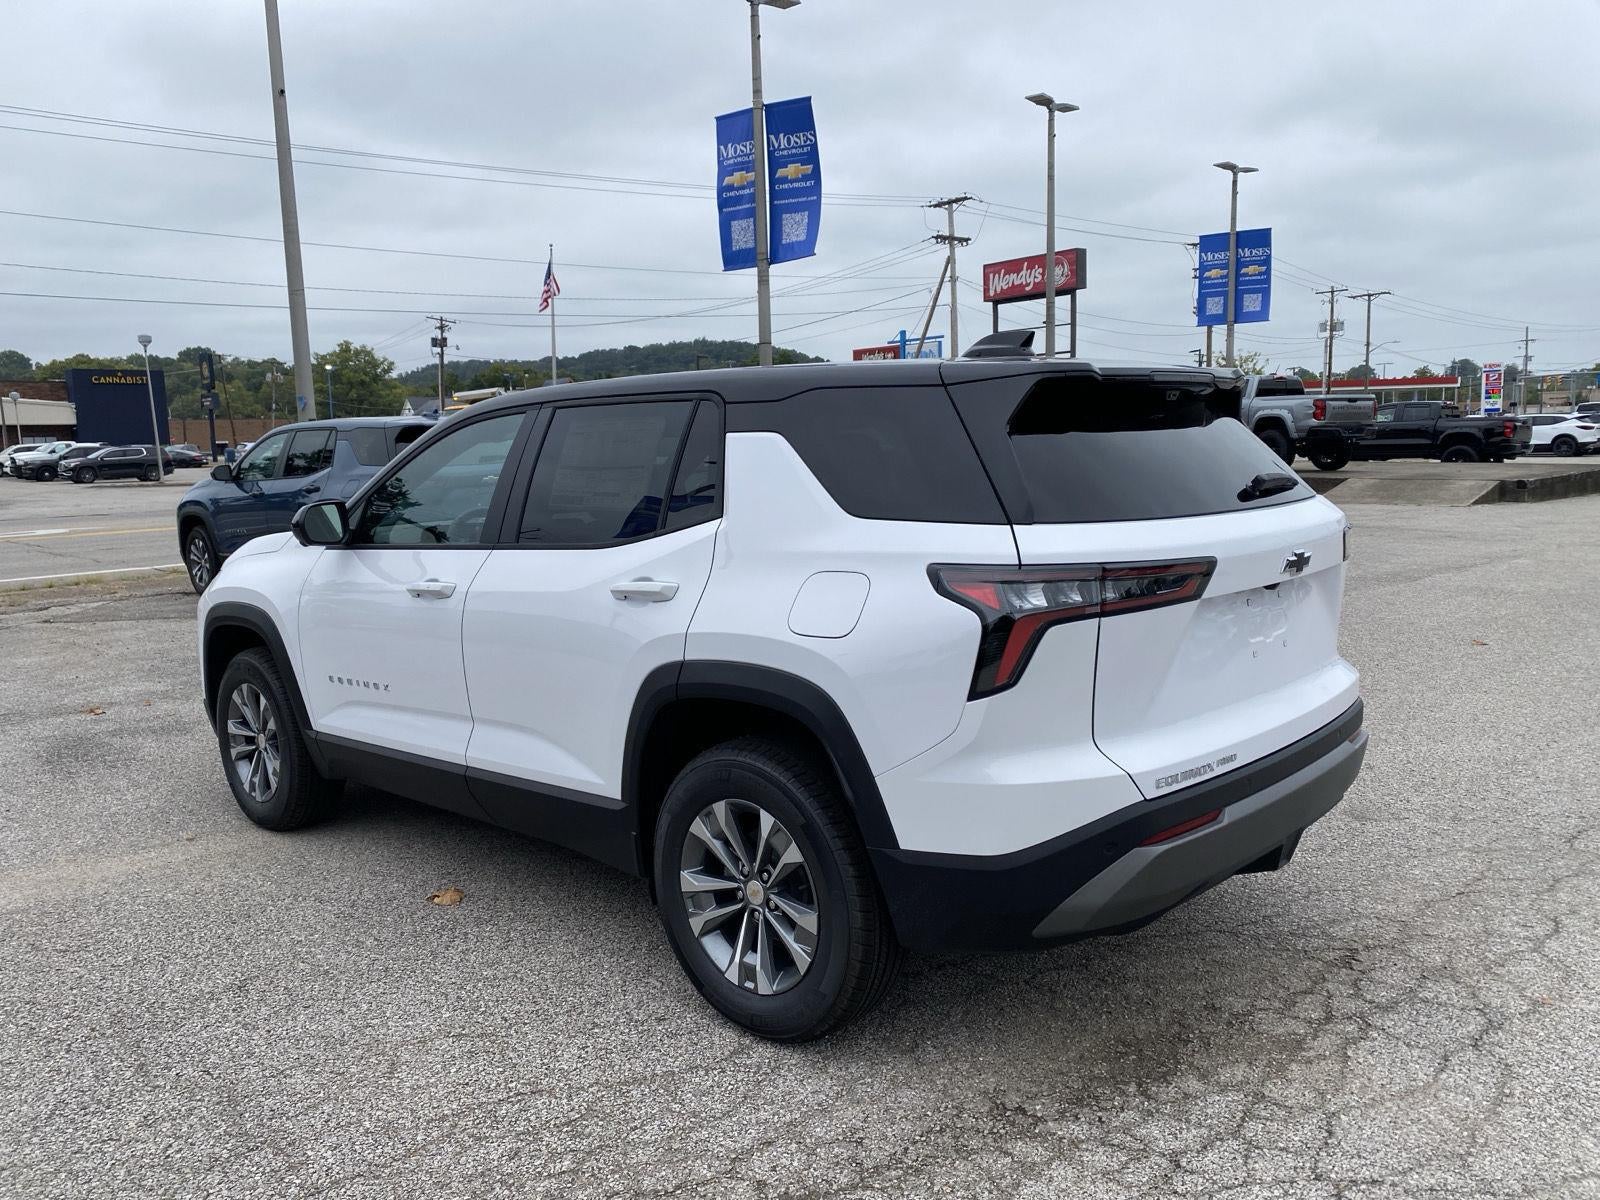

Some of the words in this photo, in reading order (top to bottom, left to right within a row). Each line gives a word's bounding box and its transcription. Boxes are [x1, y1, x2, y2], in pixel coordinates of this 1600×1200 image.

[768, 130, 815, 150] MOSES
[719, 140, 755, 160] MOSE
[774, 146, 811, 157] CHEVROLET
[775, 180, 815, 190] CHEVROLET
[722, 187, 756, 198] CHEVROLE
[1237, 247, 1271, 258] MOSES
[989, 261, 1043, 297] Wendy's
[92, 375, 149, 385] CANNABIST
[1154, 762, 1215, 790] EQUINOX
